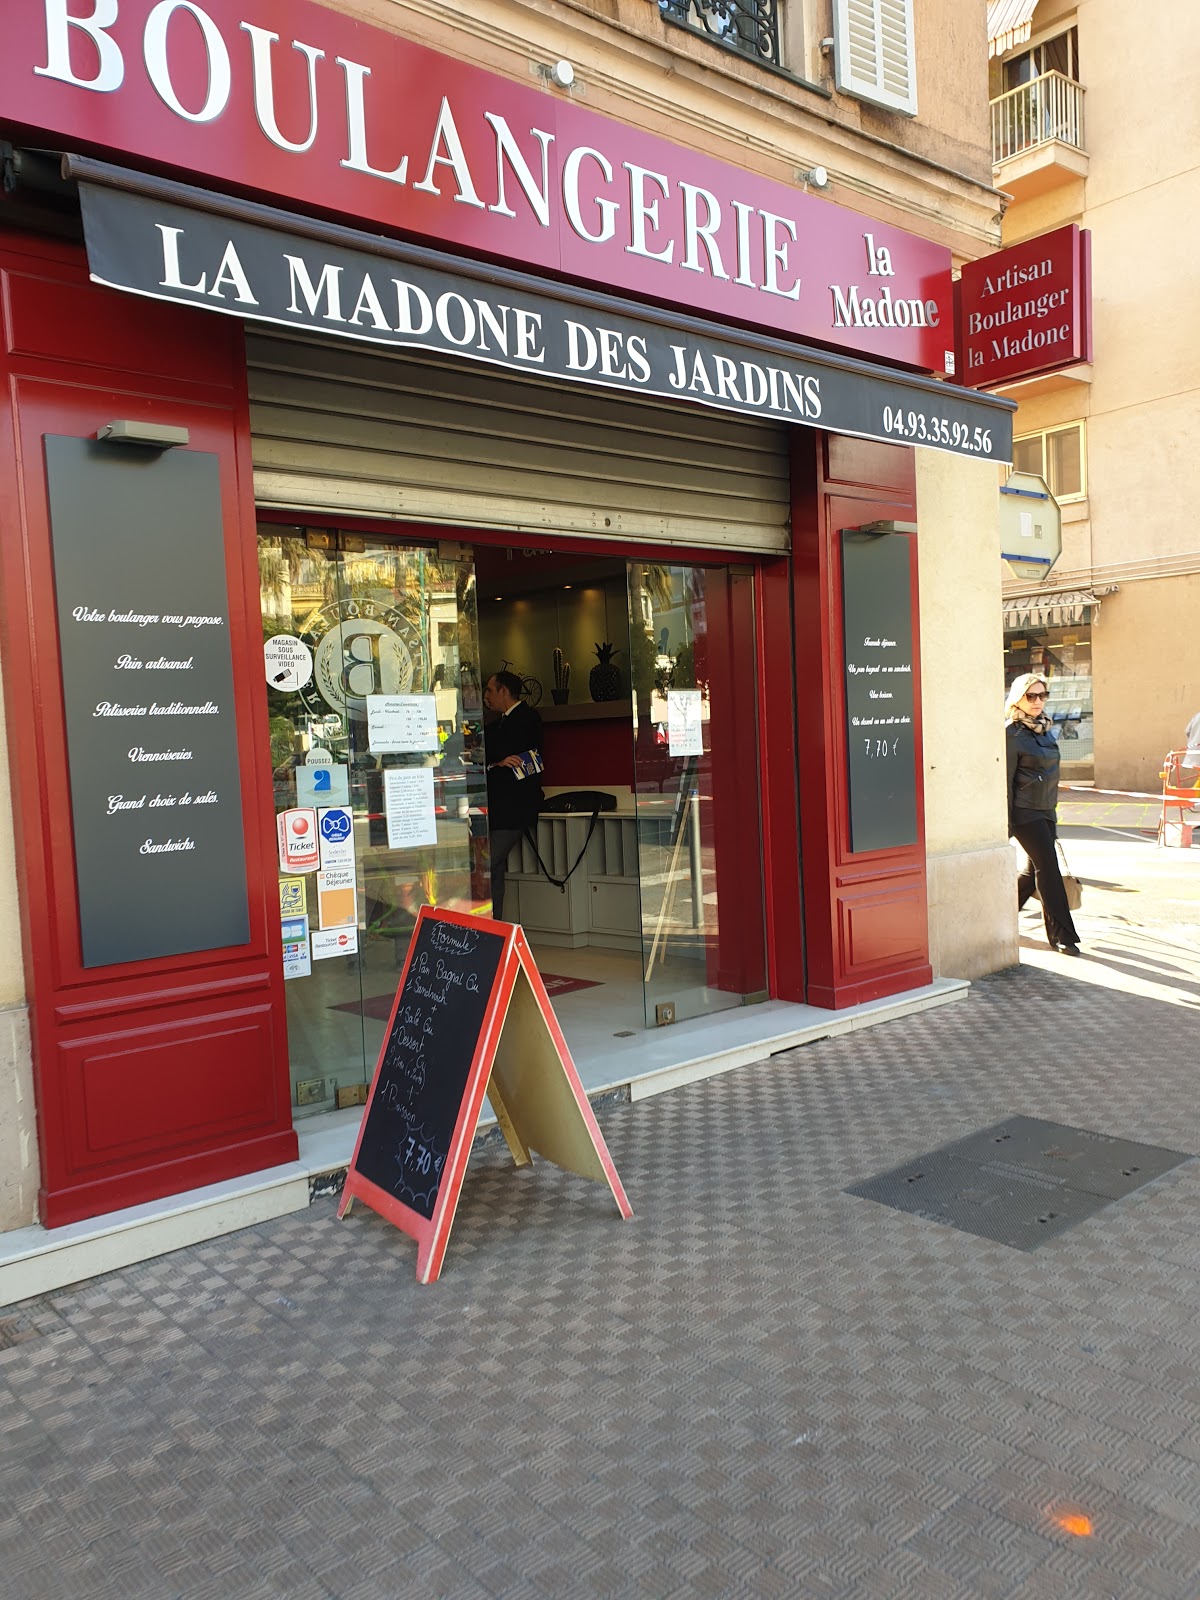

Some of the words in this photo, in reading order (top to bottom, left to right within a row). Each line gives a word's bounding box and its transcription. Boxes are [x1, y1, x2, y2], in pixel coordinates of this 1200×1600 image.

[33, 0, 801, 300] BOULANGERIE
[863, 233, 895, 276] la
[980, 255, 1054, 299] Artisan
[831, 285, 939, 328] Madone
[968, 287, 1070, 336] Boulanger
[155, 223, 259, 305] LA
[283, 254, 545, 363] MADONE
[565, 320, 651, 383] DES
[669, 345, 822, 419] JARDINS
[968, 345, 985, 369] la
[990, 323, 1070, 363] Madone
[883, 406, 992, 453] 04.93.35.92.56
[72, 606, 105, 622] Votre
[108, 609, 159, 628] boulanger
[161, 614, 183, 624] vous
[178, 614, 225, 628] propose.
[272, 639, 298, 647] MAGASIN
[114, 654, 143, 669] Pain
[145, 656, 194, 669] artisanal.
[265, 653, 307, 661] SURVEILLANCE
[278, 660, 295, 668] VIDEO
[149, 701, 220, 716] traditionnelles.
[127, 747, 193, 762] Viennoiseries.
[864, 739, 888, 759] 7,70
[106, 794, 146, 815] Grand
[148, 793, 176, 808] choix
[178, 791, 191, 805] de
[192, 790, 219, 804] salés.
[139, 837, 195, 854] Sandwichs.
[288, 841, 314, 851] Ticket
[325, 872, 349, 880] Chèque
[326, 878, 353, 887] Déjeuner
[437, 924, 470, 951] Formule
